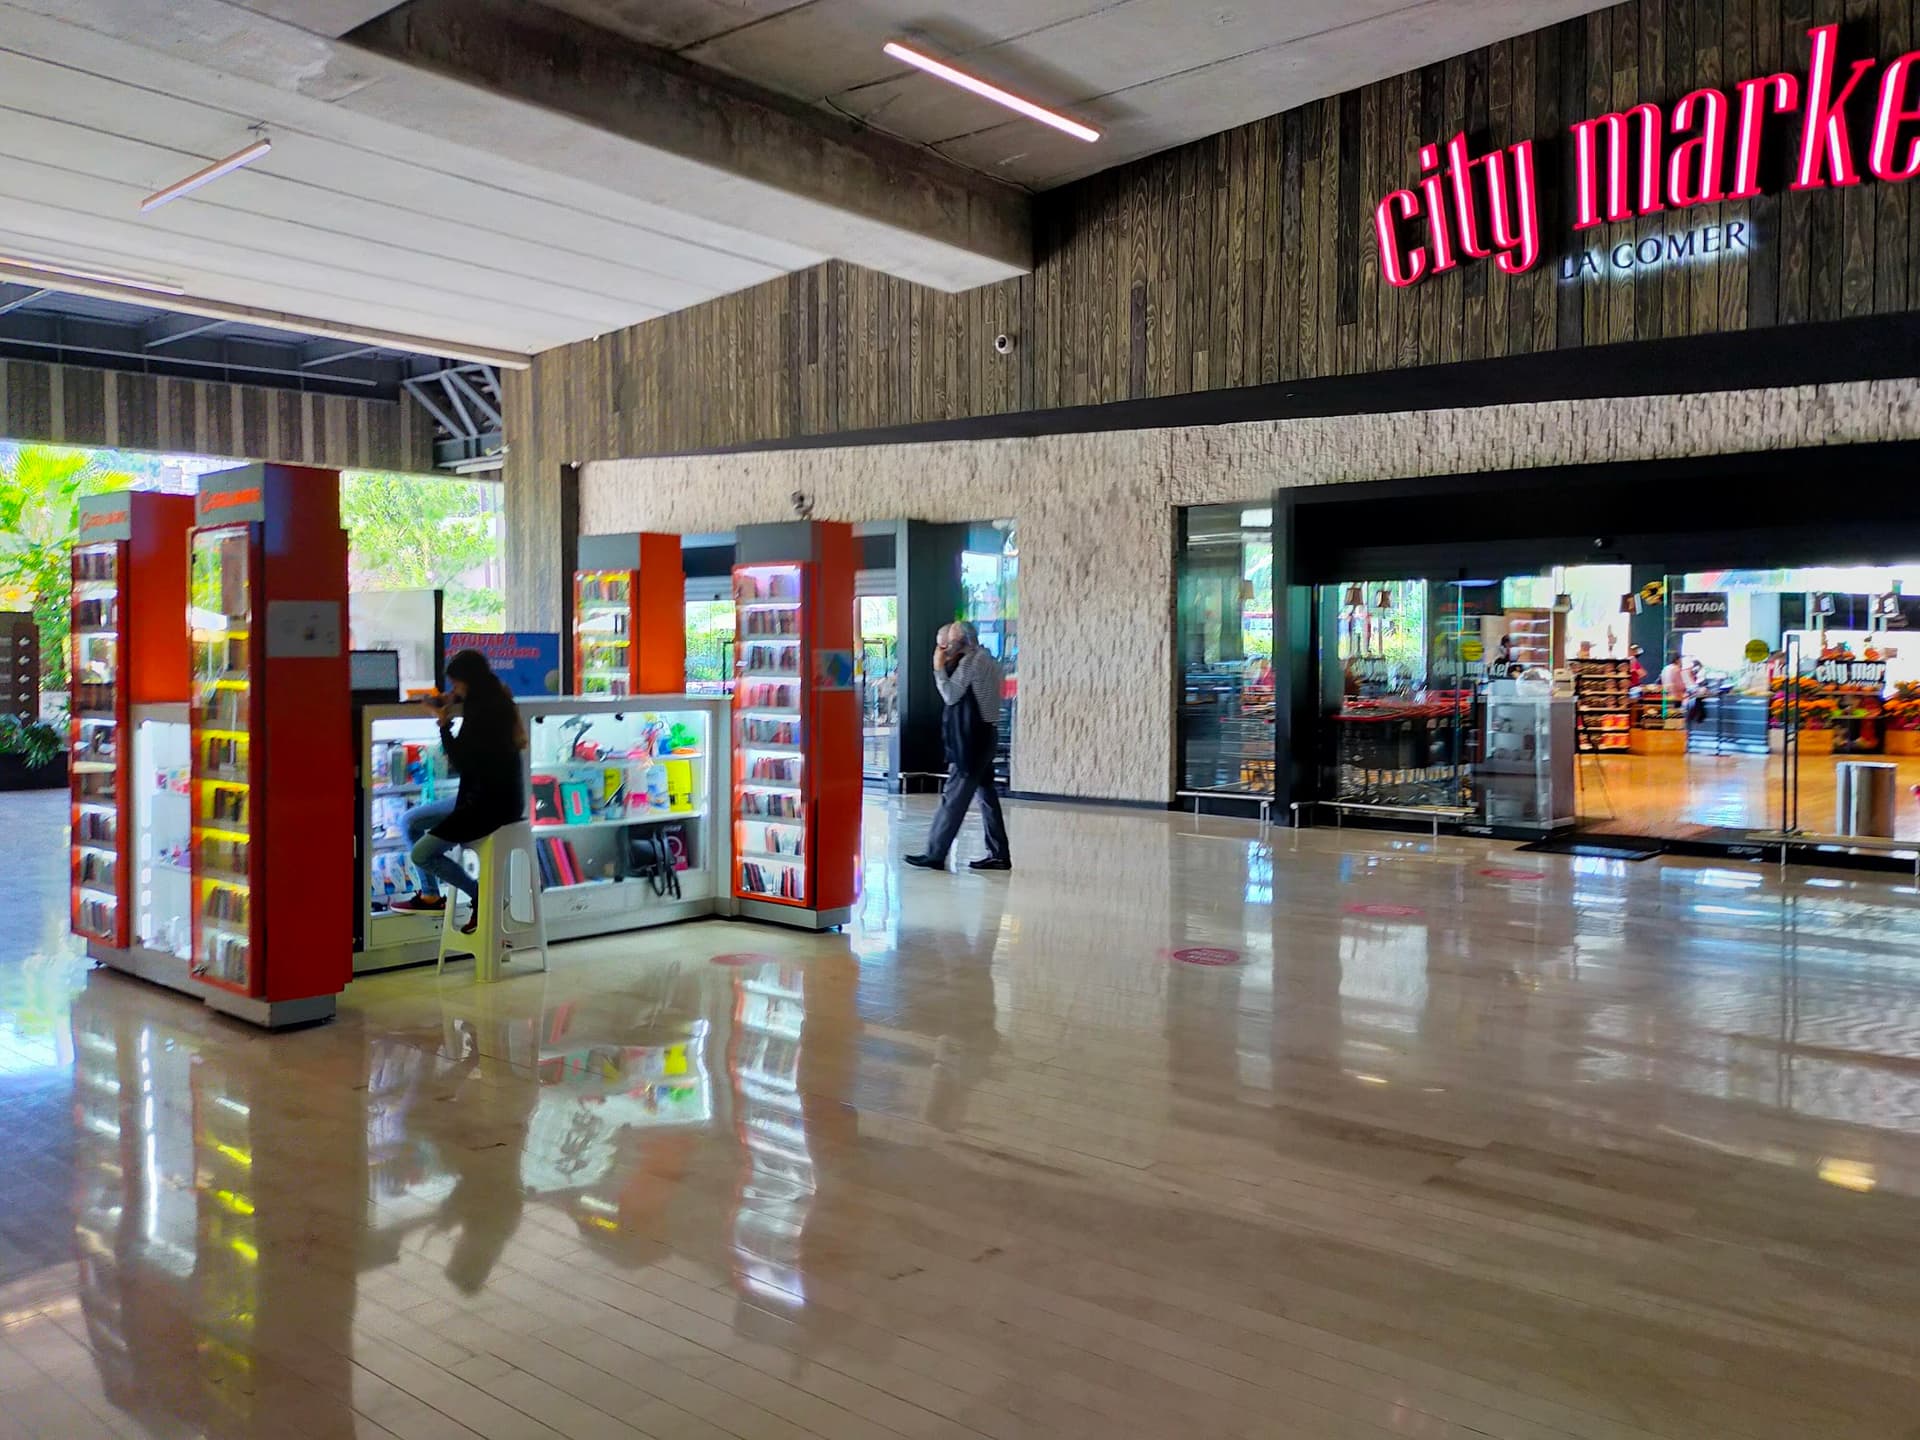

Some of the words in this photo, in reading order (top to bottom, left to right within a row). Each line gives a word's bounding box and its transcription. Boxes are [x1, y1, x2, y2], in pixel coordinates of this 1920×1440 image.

[1375, 130, 1539, 287] city
[1560, 251, 1599, 279] LA
[1612, 220, 1748, 269] COMER
[1674, 601, 1726, 613] ENTRADA
[1816, 660, 1848, 684] city
